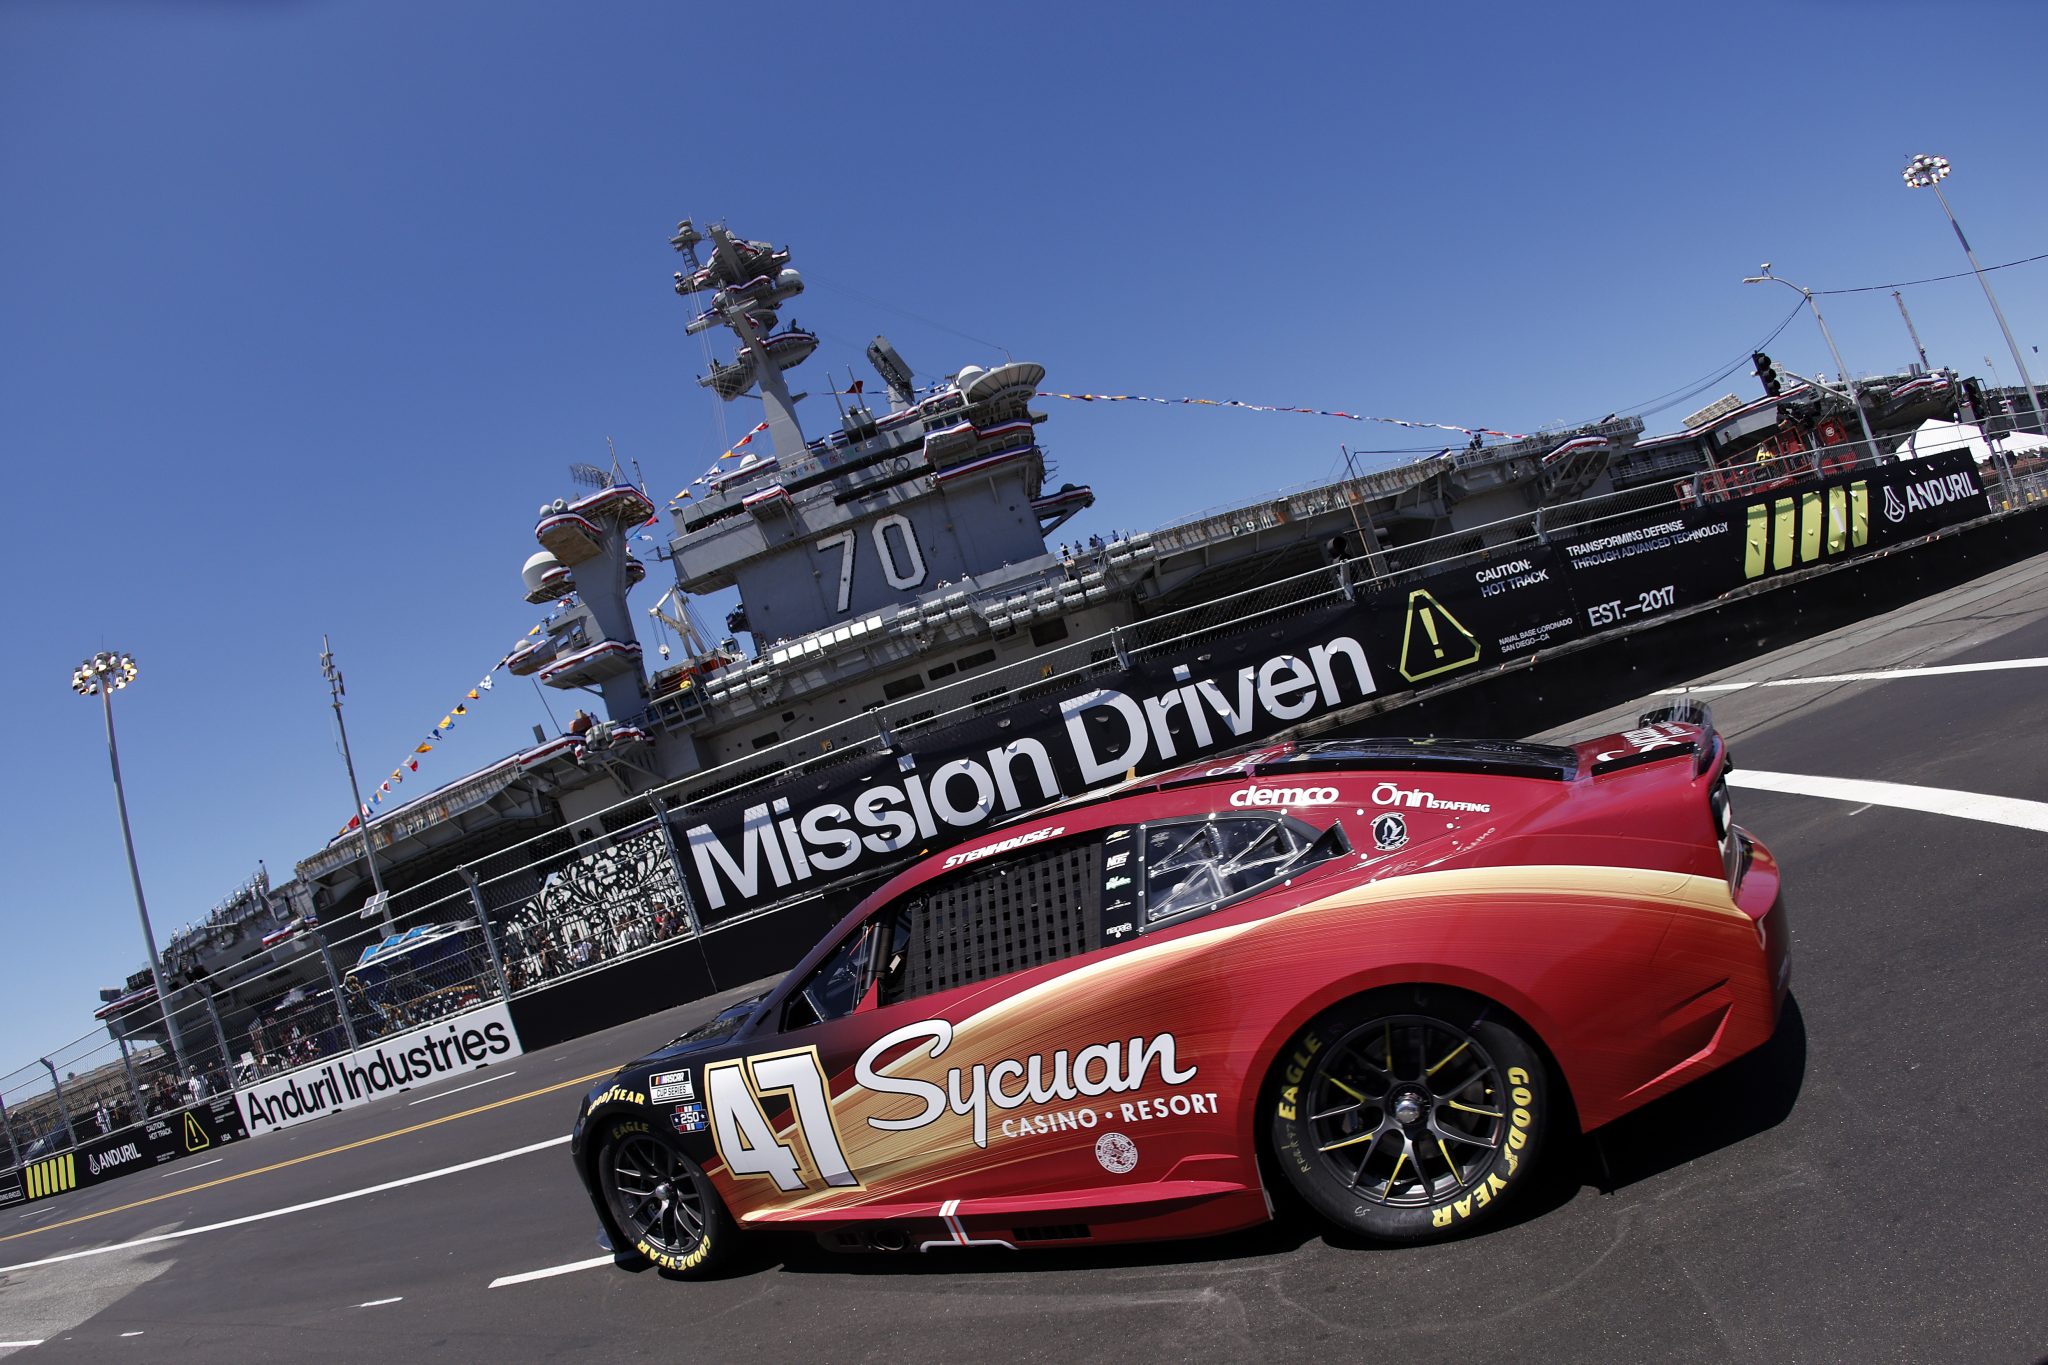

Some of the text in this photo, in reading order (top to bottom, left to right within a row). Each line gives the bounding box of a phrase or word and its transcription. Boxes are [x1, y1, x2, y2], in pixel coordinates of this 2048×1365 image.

[1905, 471, 1979, 513] ANDURIL
[1566, 519, 1685, 557] TRANSFORMING DEFENSE
[1571, 521, 1729, 570] THROUGH ADVANCED TECHNOLOGY
[816, 513, 929, 614] 70
[1475, 559, 1532, 583] CAUTION:
[1480, 569, 1550, 598] HOT TRACK
[1499, 617, 1573, 647] NAVAL BASE CORONADO
[1501, 643, 1516, 653] SAN
[685, 635, 1377, 911] Mission Driven
[1230, 785, 1339, 808] clemco
[1431, 800, 1491, 813] STAFFING
[942, 827, 1054, 870] STENHOUSE
[247, 1066, 341, 1131] Anduril
[340, 1021, 511, 1101] Industries
[656, 1085, 687, 1098] CUP SERIES
[660, 1072, 685, 1084] NASCAR
[853, 1018, 1198, 1149] Sycuan
[1278, 1032, 1322, 1121] EAGLE
[148, 1127, 173, 1140] HOT TRACK
[612, 1121, 649, 1140] EAGLE
[680, 1111, 700, 1125] 250
[704, 1044, 866, 1194] 47
[1001, 1092, 1219, 1140] CASINO RESORT
[99, 1142, 142, 1170] ANDURIL
[1432, 1065, 1533, 1230] GOODYEAR
